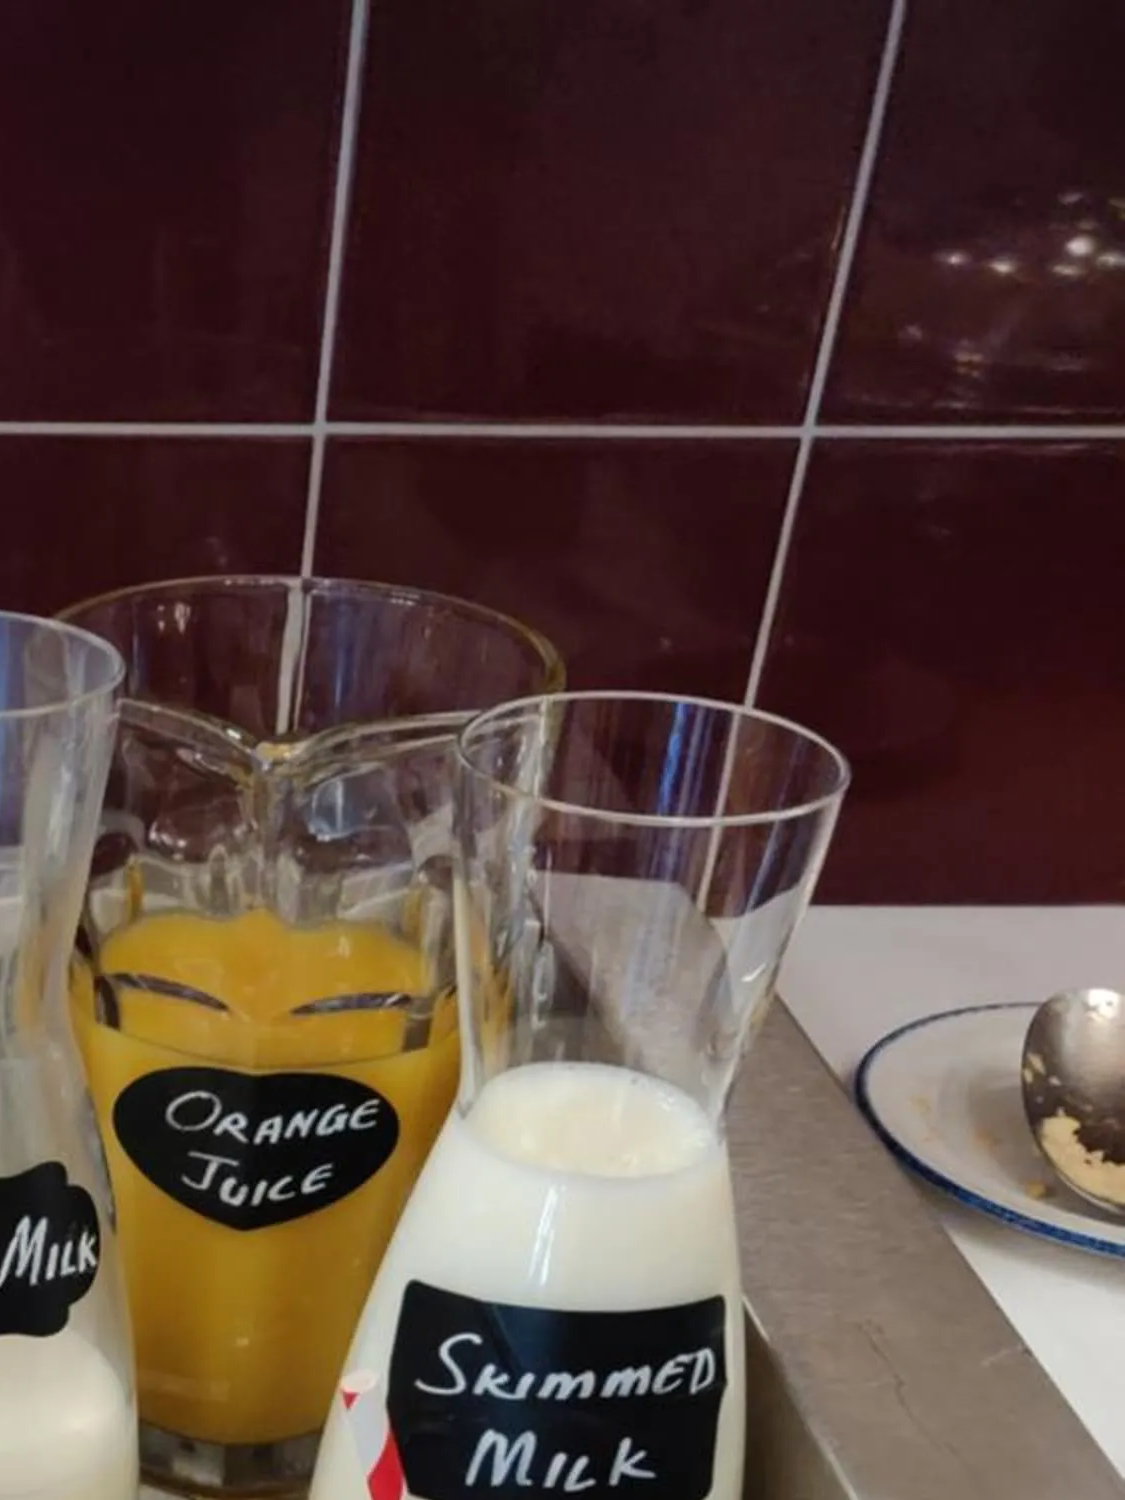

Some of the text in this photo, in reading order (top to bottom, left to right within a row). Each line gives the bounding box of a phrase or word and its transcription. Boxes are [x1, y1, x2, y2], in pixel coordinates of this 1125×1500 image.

[166, 1090, 380, 1145] ORANGE
[182, 1150, 333, 1207] JUICE
[465, 1429, 656, 1491] MILK
